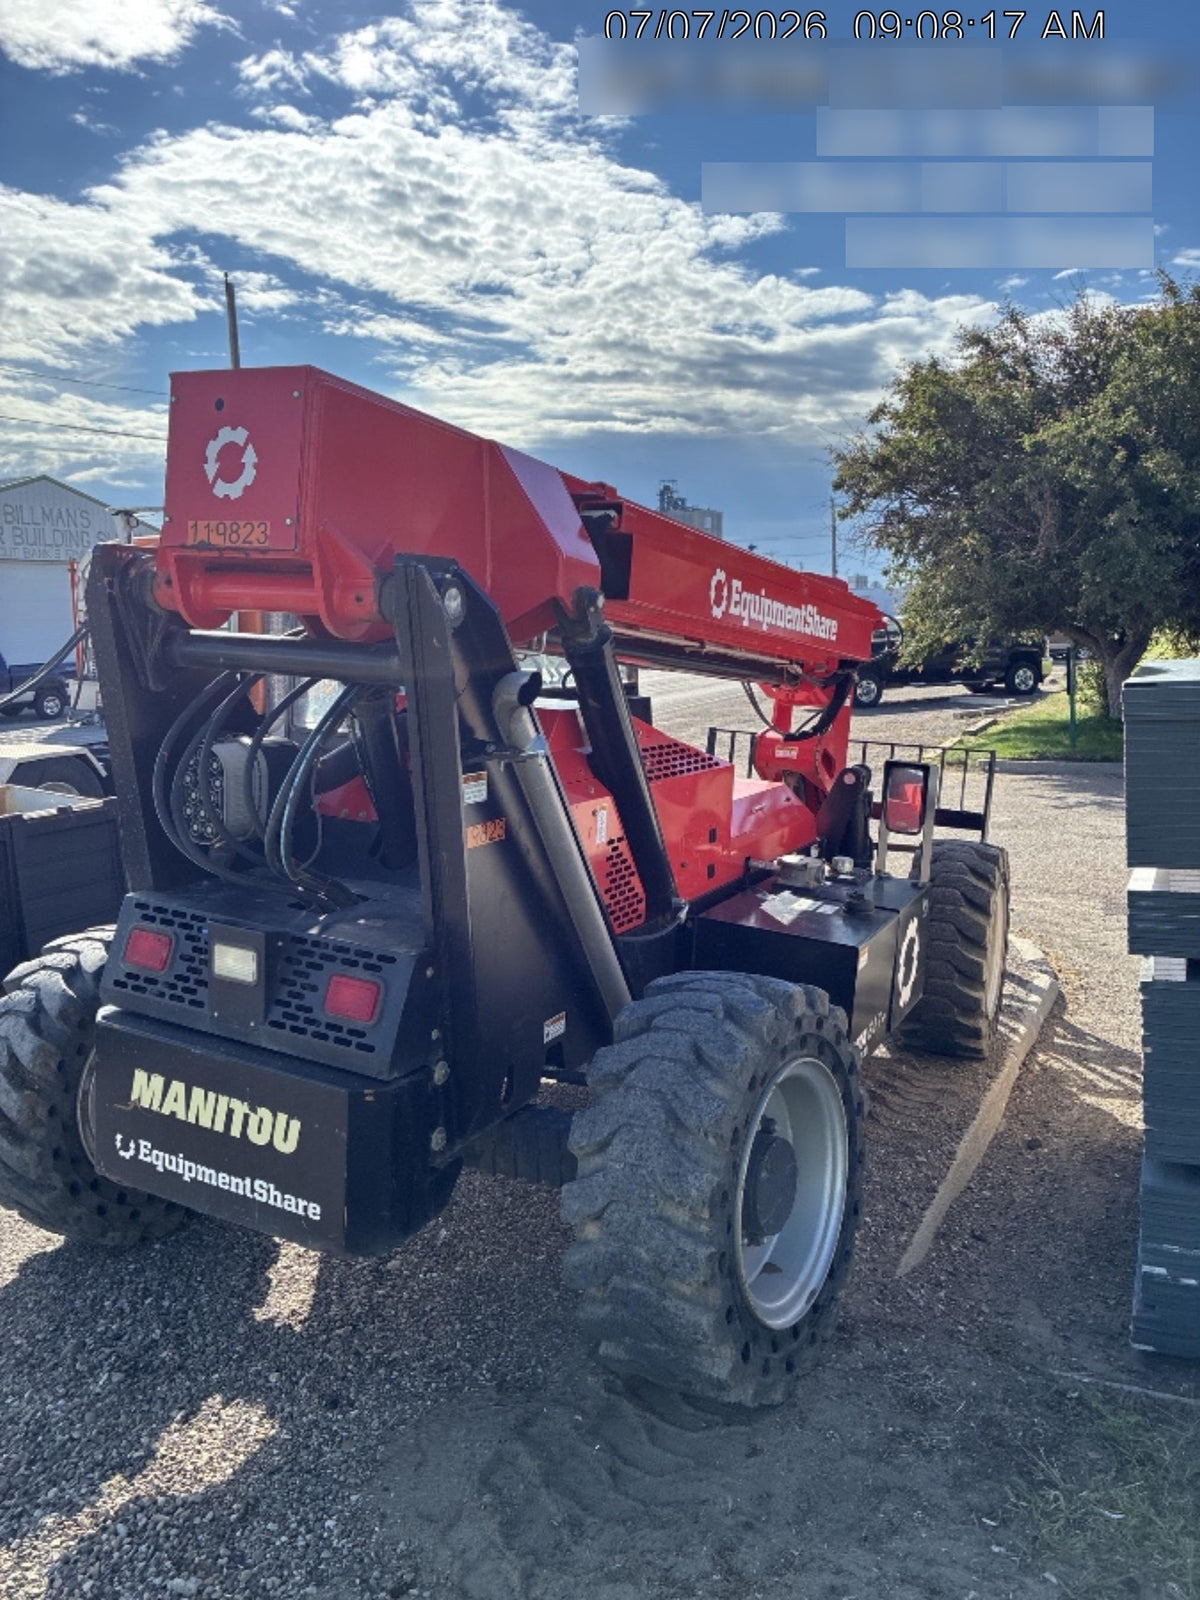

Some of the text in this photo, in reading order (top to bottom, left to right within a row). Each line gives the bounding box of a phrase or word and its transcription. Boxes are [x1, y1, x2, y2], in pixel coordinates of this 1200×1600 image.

[12, 526, 91, 548] BUILDING
[190, 521, 268, 545] 119823
[729, 579, 838, 641] EquipmentShare
[131, 1068, 301, 1154] MANITOU
[137, 1138, 321, 1220] EquipmentShare
